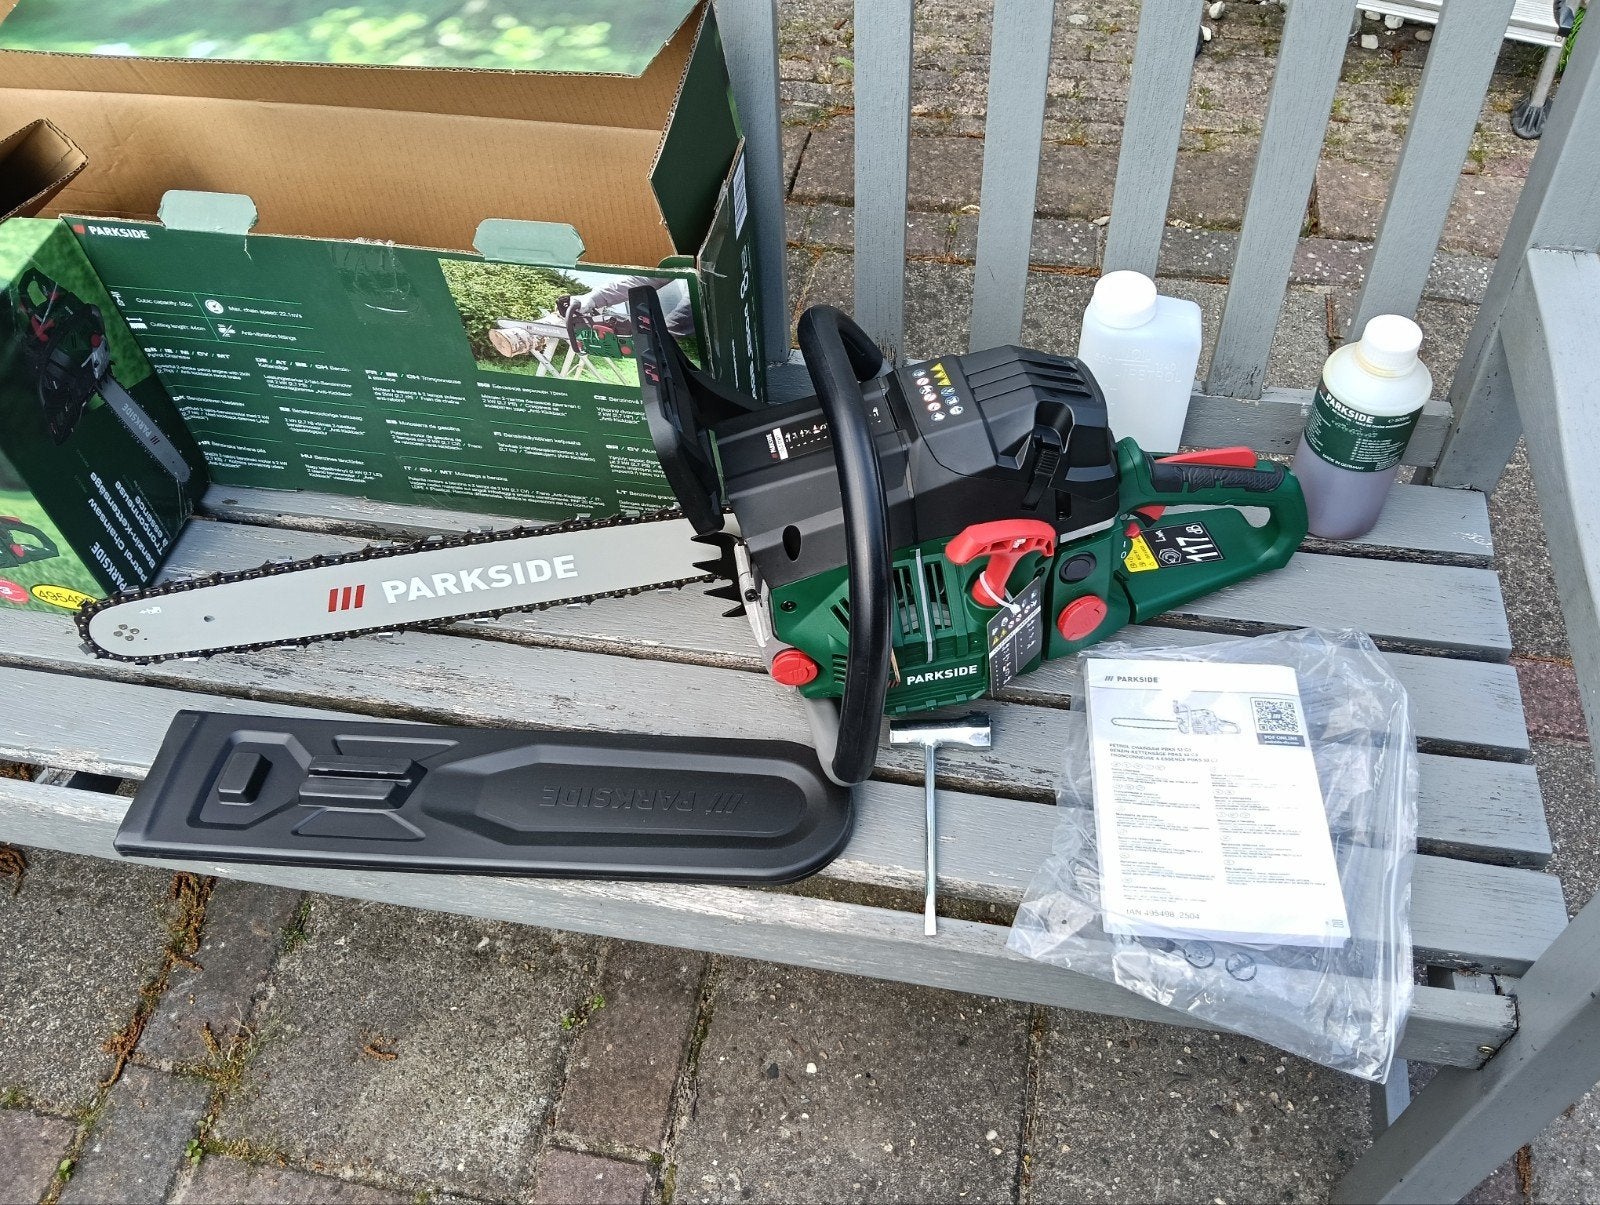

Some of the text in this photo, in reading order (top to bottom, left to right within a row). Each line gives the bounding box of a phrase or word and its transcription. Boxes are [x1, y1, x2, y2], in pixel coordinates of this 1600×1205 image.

[88, 225, 150, 240] PARKSIDE
[121, 403, 152, 438] PARKSIDE
[1326, 393, 1375, 424] PARKSIDE
[1323, 454, 1334, 463] MADE
[88, 498, 125, 550] chainsaw
[90, 472, 156, 569] Benzin-Kettensäge
[115, 480, 163, 555] Tronçonneuse
[135, 495, 169, 548] à essence
[1186, 524, 1203, 534] dB
[124, 548, 147, 583] Petrol
[1175, 537, 1217, 561] 117
[91, 542, 128, 592] PARKSIDE
[382, 554, 578, 604] PARKSIDE
[907, 664, 977, 685] PARKSIDE
[539, 786, 696, 812] PARKSIDE
